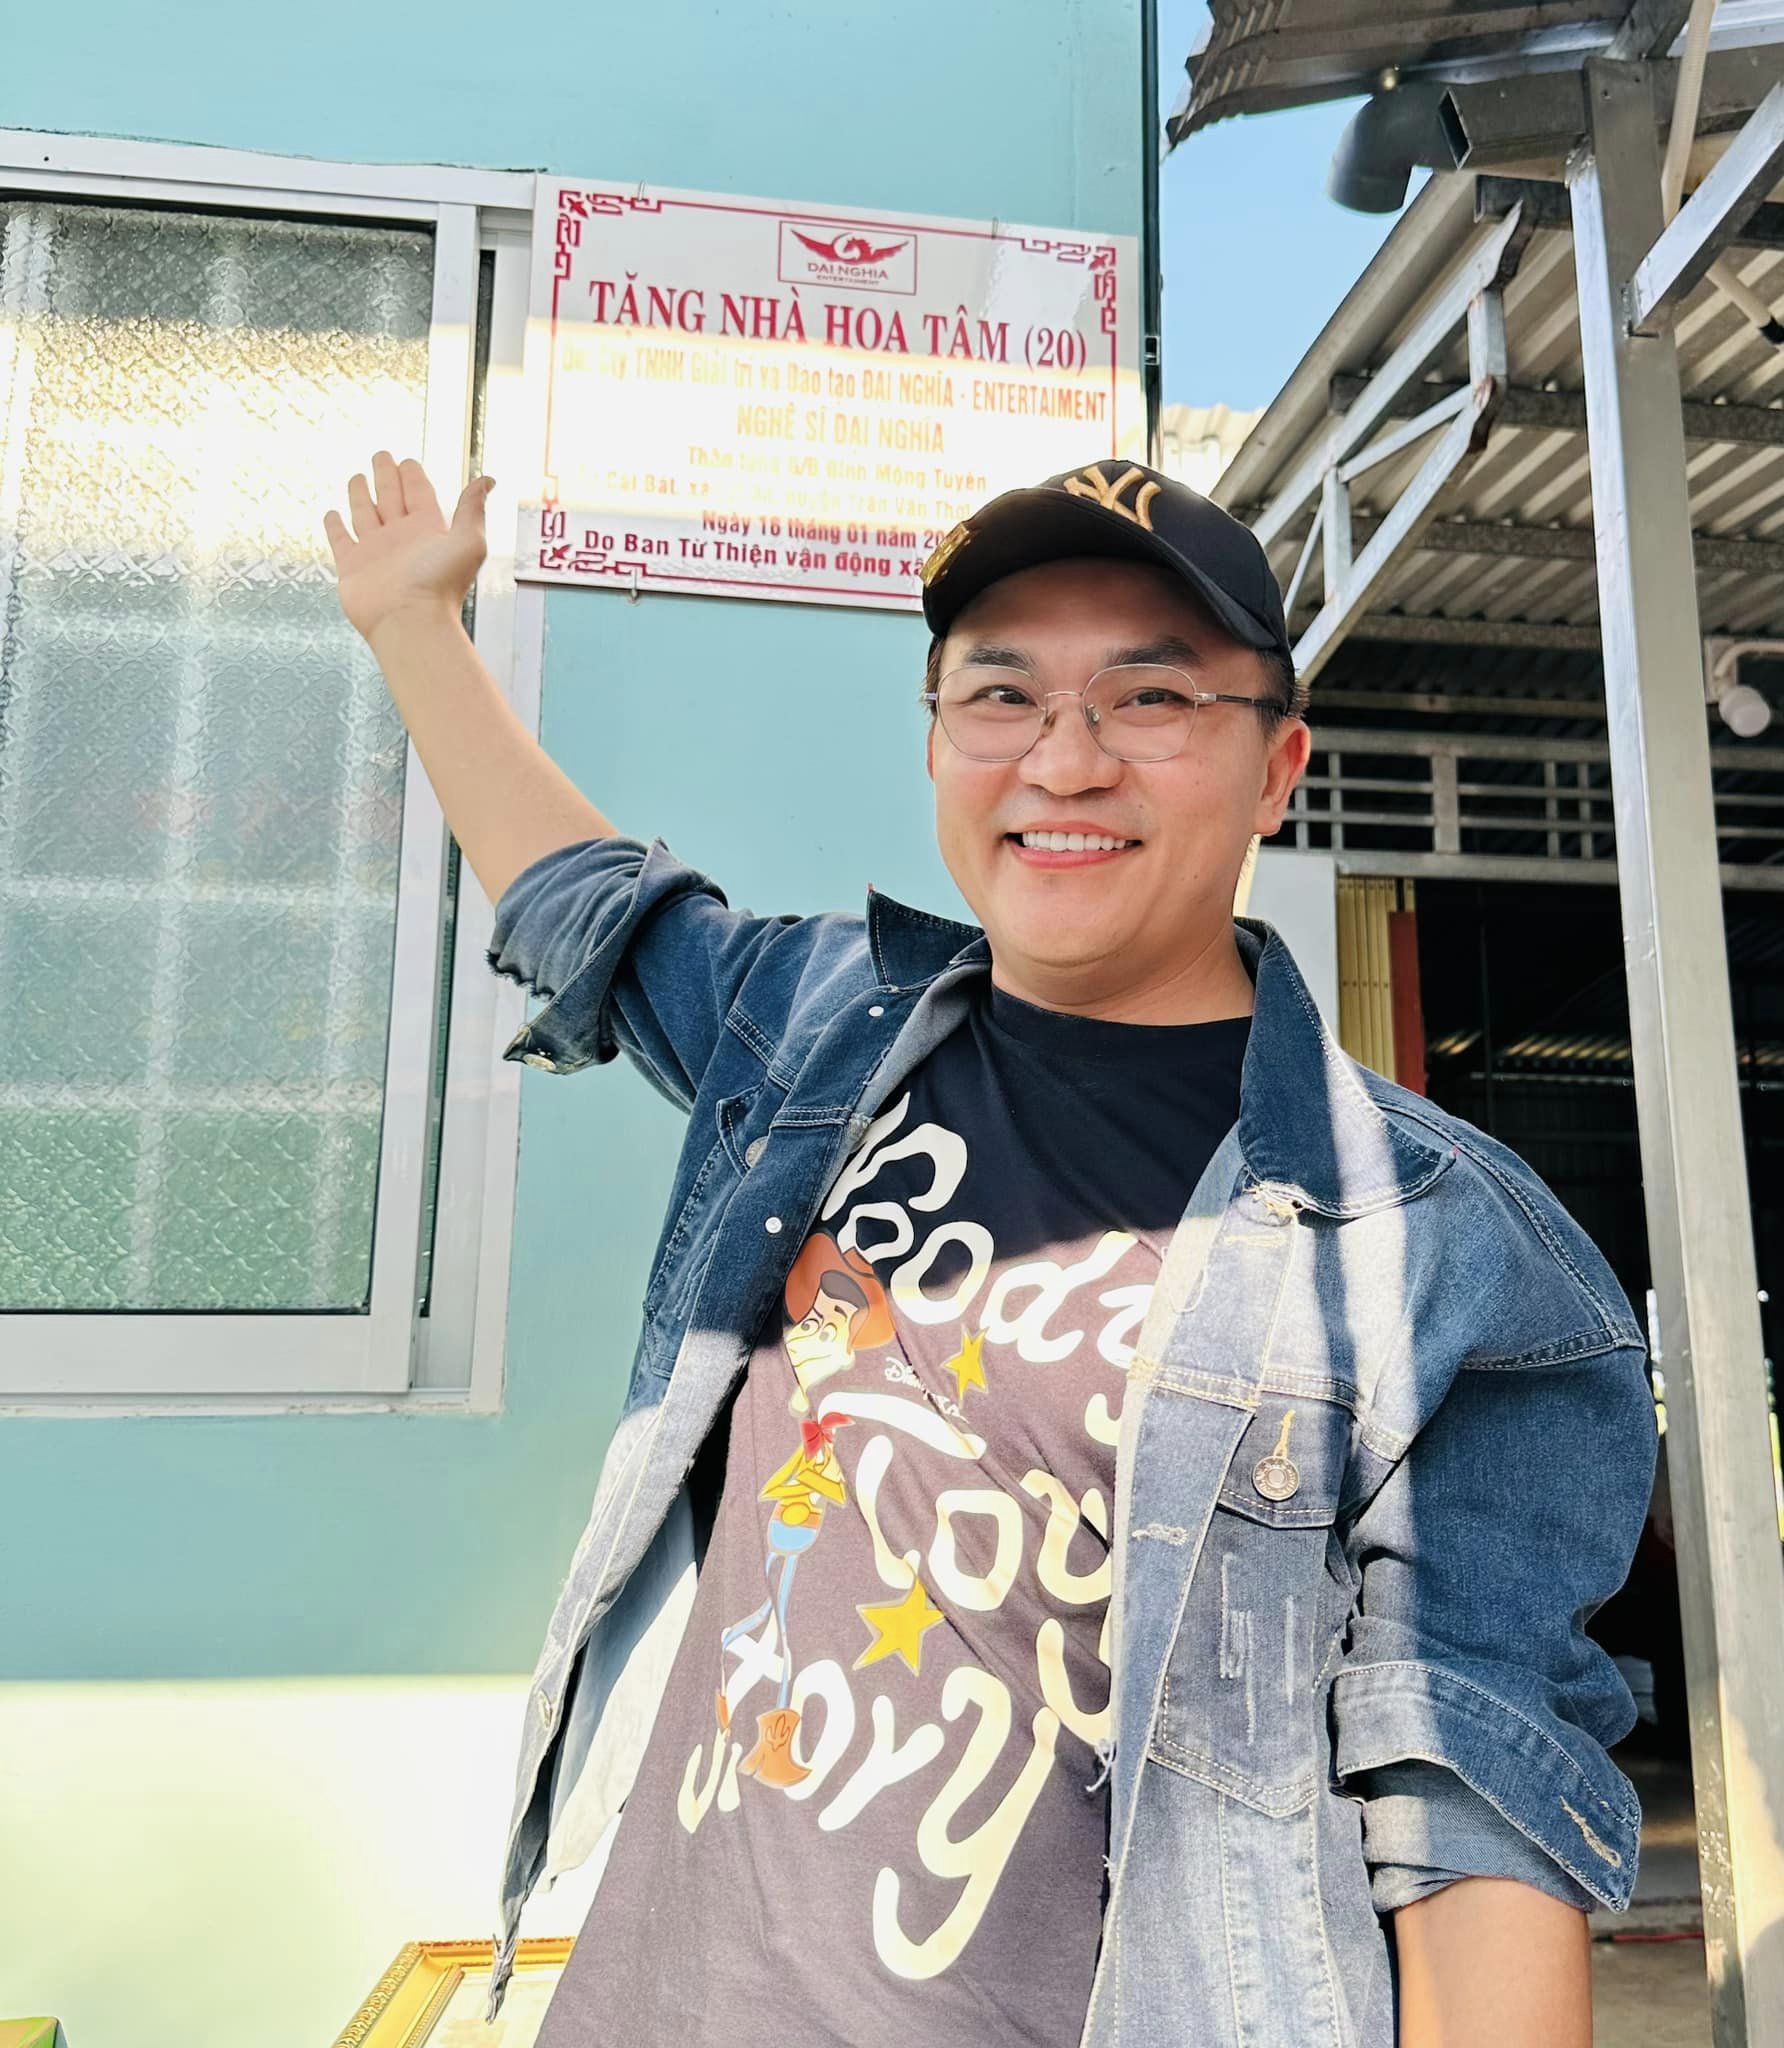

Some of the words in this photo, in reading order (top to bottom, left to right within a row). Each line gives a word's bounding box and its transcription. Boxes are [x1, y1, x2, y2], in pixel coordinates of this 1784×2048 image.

[720, 285, 808, 344] NHÀ
[824, 304, 909, 355] HOA
[922, 304, 1010, 364] TÂM
[1024, 324, 1087, 376] (20)
[973, 379, 1107, 423] ENTERTAIMENT
[702, 509, 751, 536] Ngày
[759, 515, 781, 536] 16
[788, 517, 841, 545] tháng
[847, 521, 868, 545] 01
[876, 525, 917, 549] năm
[624, 534, 669, 556] Ban
[714, 541, 777, 568] Thiện
[786, 547, 827, 573] vận
[835, 551, 891, 577] động
